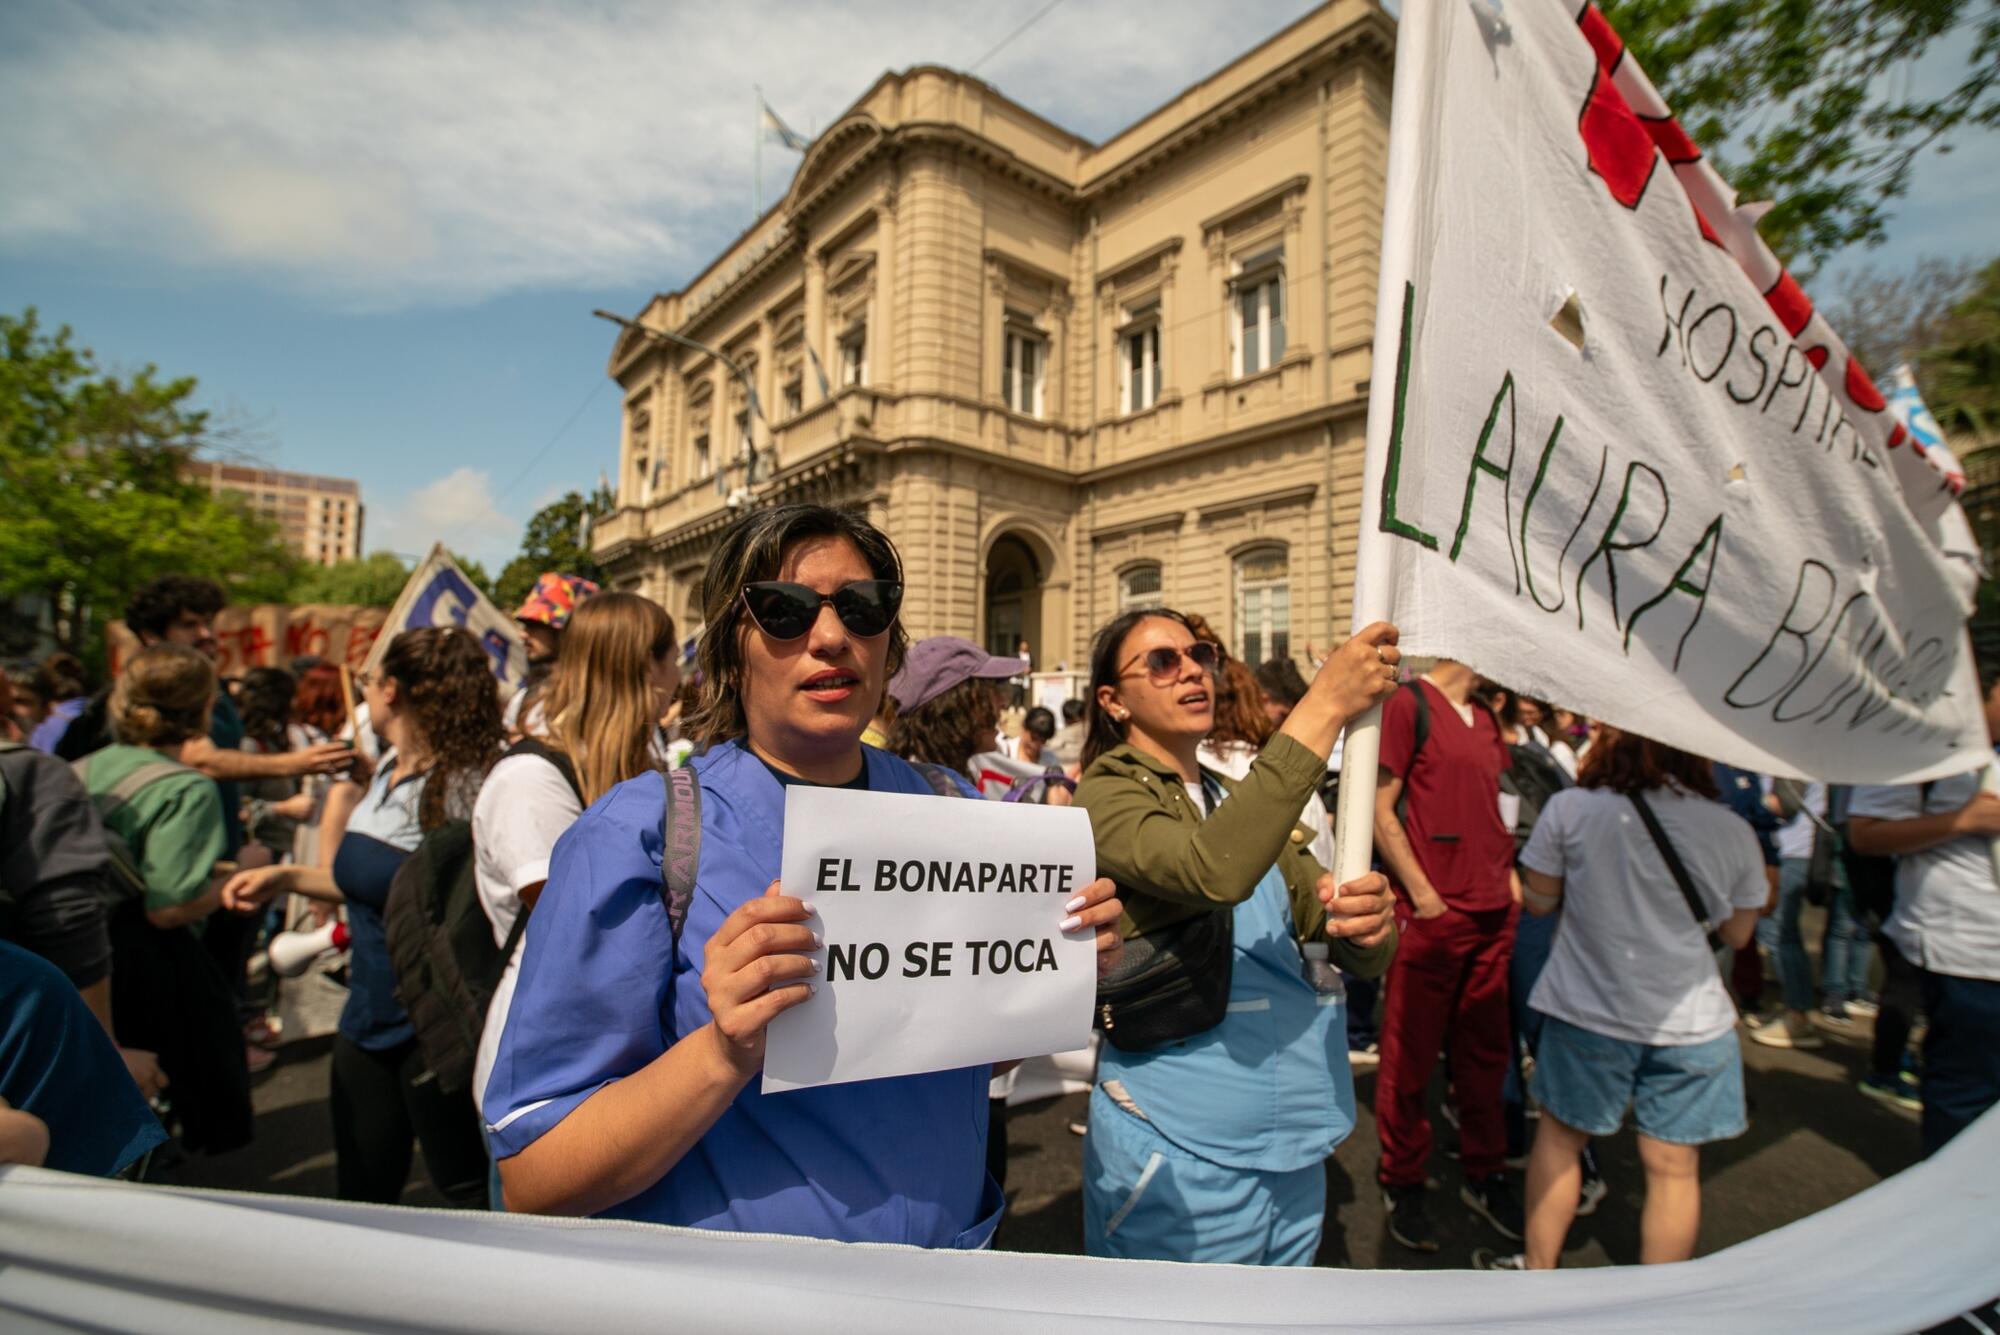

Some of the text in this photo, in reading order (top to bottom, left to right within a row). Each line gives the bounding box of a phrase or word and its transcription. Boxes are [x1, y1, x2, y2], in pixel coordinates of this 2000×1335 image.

[1379, 280, 1724, 672] LAURA
[816, 858, 1074, 893] EL BONAPARTE
[826, 938, 1059, 982] NO SE TOCA
